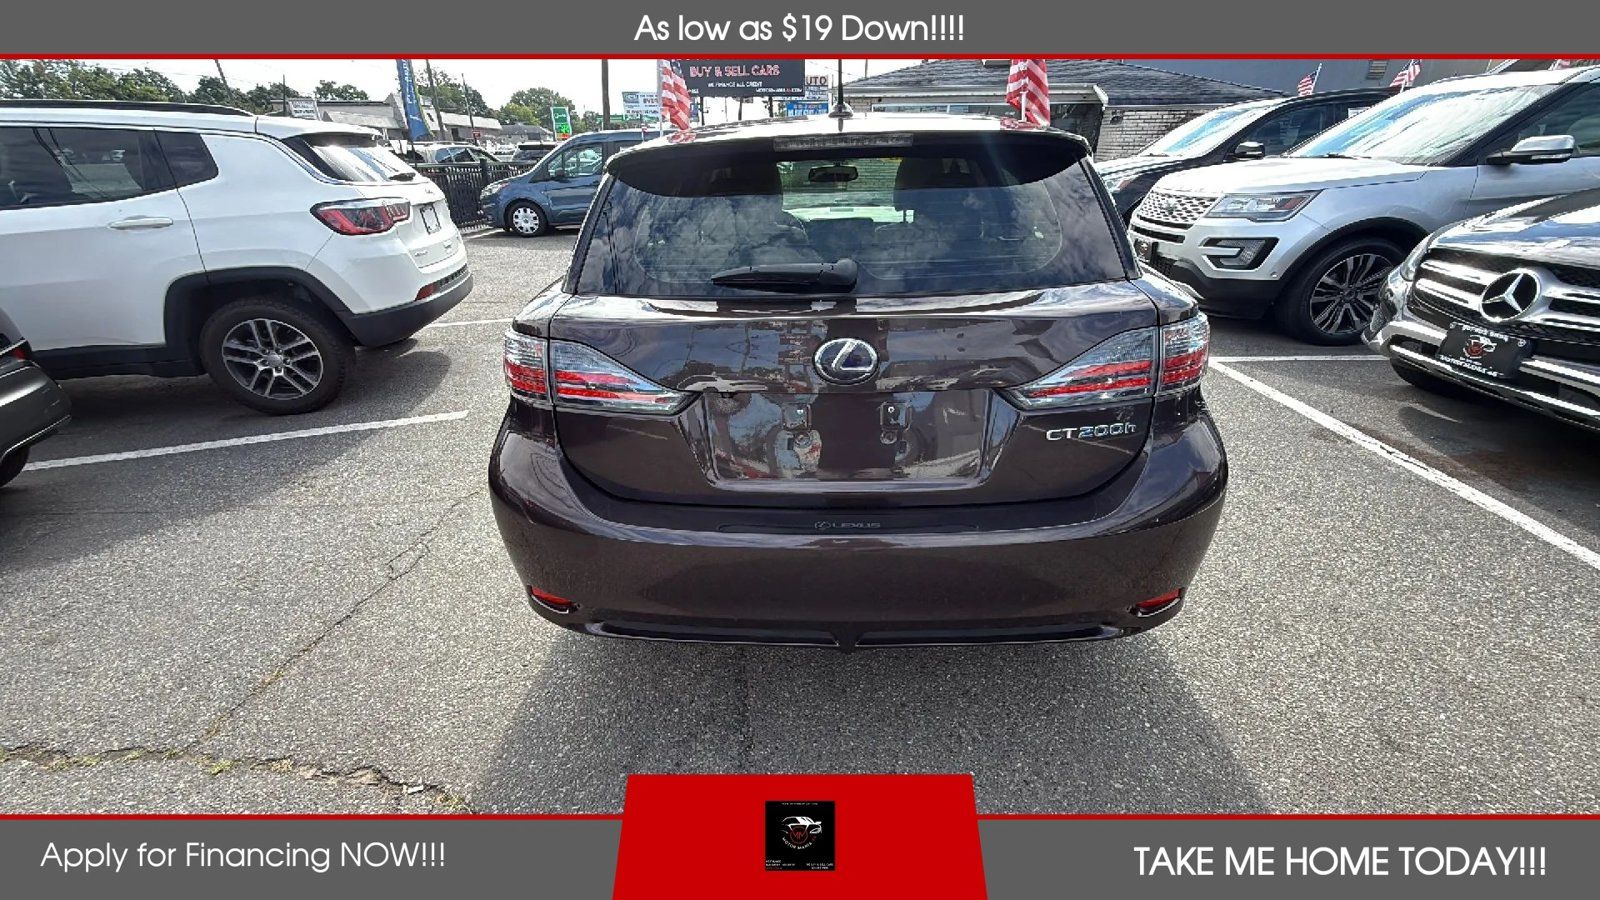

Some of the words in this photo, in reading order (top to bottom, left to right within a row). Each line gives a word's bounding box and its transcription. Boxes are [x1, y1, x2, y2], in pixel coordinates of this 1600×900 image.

[689, 66, 713, 78] BUY
[724, 65, 750, 77] SELL
[751, 64, 780, 76] CARS
[806, 76, 827, 86] UTO
